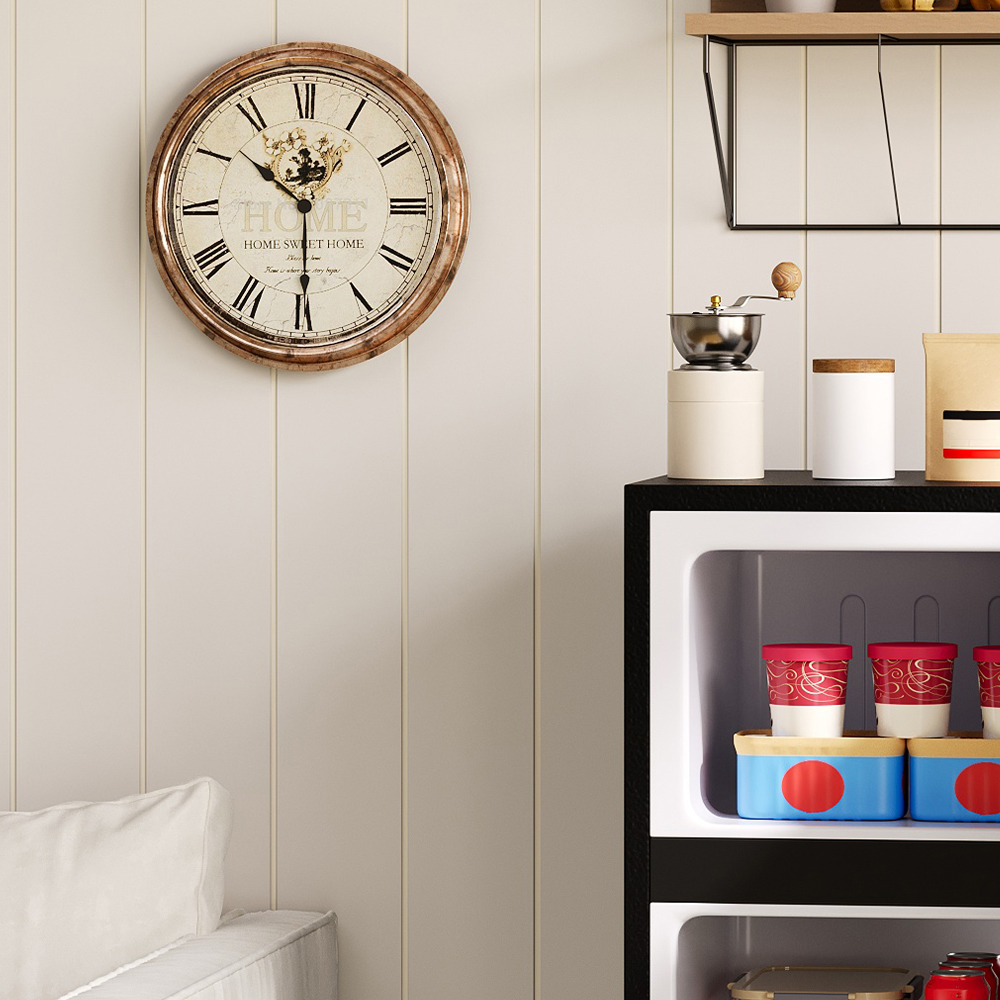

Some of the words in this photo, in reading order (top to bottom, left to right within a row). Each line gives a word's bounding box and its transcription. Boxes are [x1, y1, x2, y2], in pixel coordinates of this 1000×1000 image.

[241, 200, 368, 233] HOME
[244, 239, 281, 250] HOME
[327, 239, 365, 250] HOME
